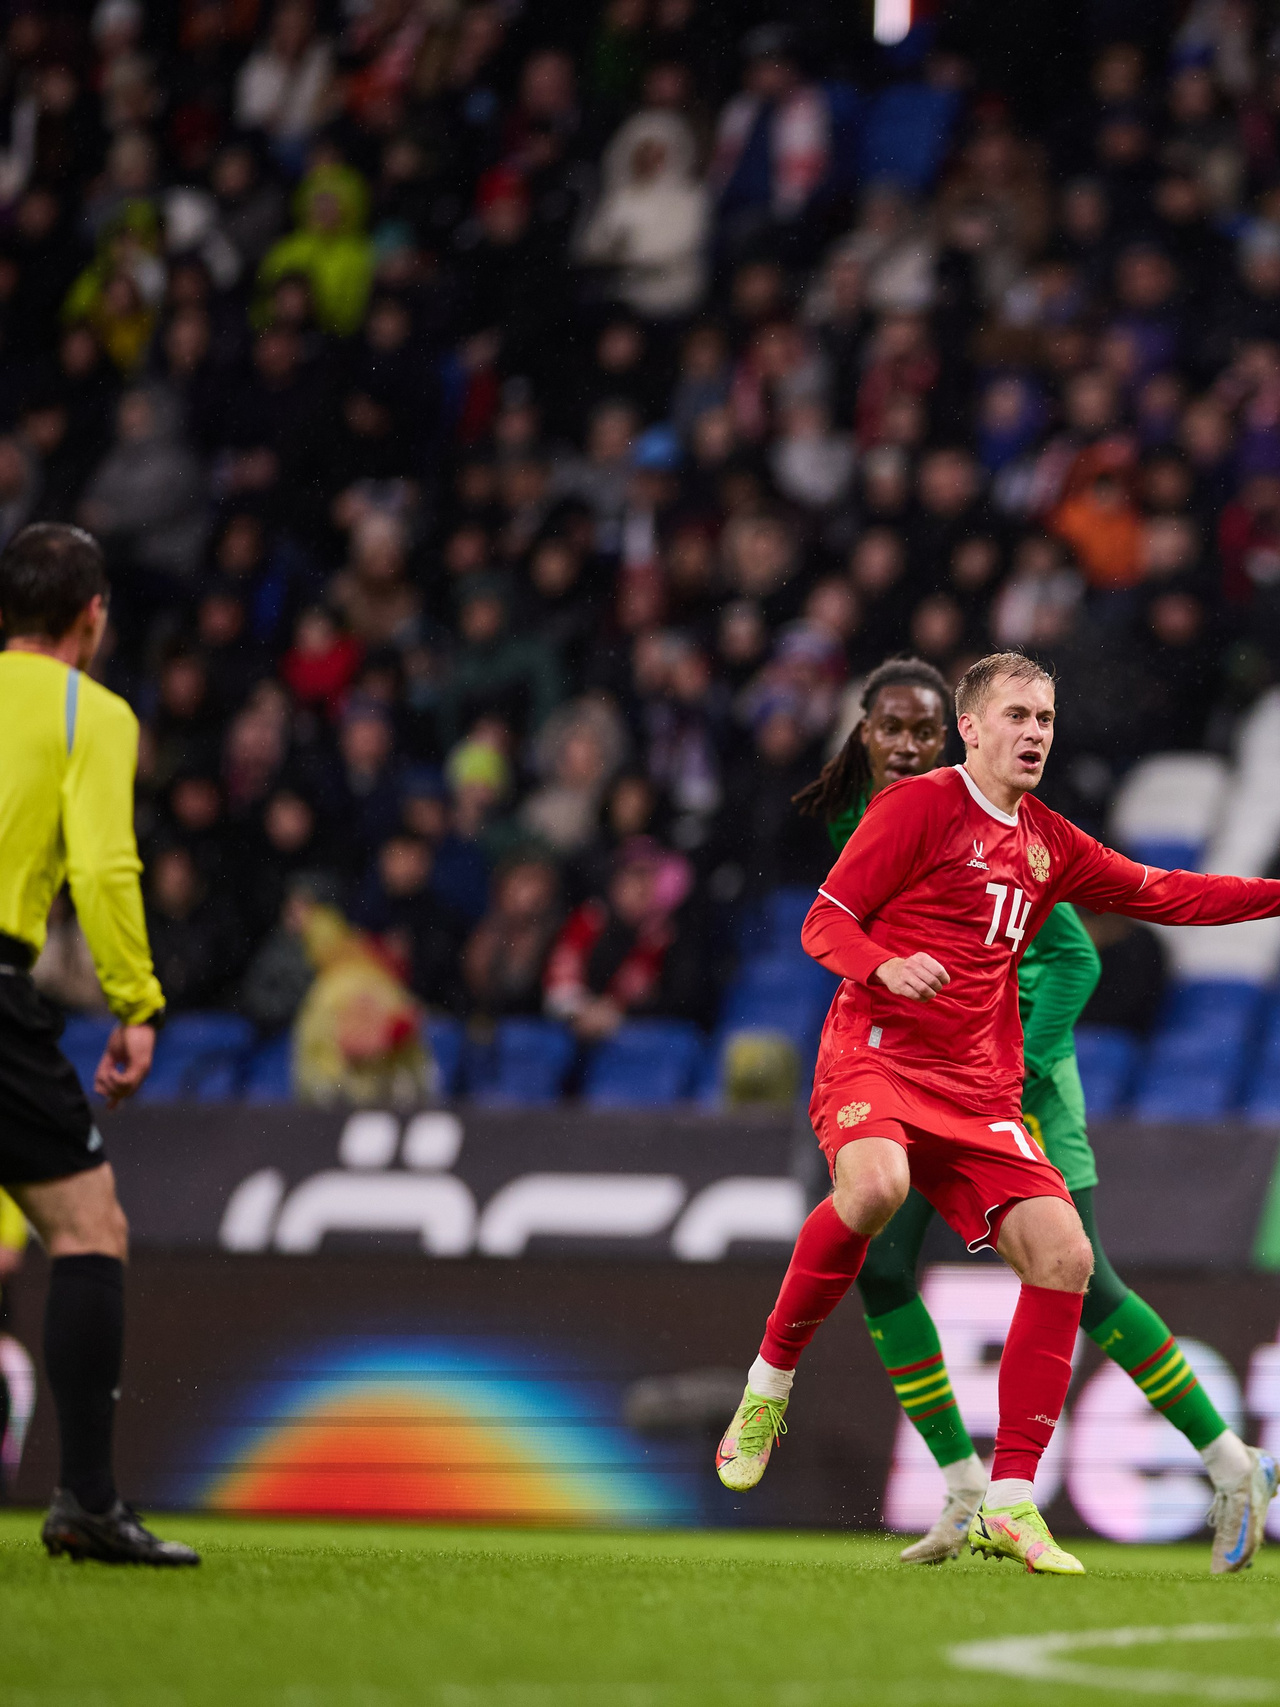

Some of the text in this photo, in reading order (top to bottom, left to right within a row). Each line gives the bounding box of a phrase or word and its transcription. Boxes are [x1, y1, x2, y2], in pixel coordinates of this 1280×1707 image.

[966, 859, 990, 870] JÖGEL
[984, 882, 1032, 953] 74
[987, 1121, 1044, 1161] 7
[1026, 1413, 1057, 1428] JÖG
